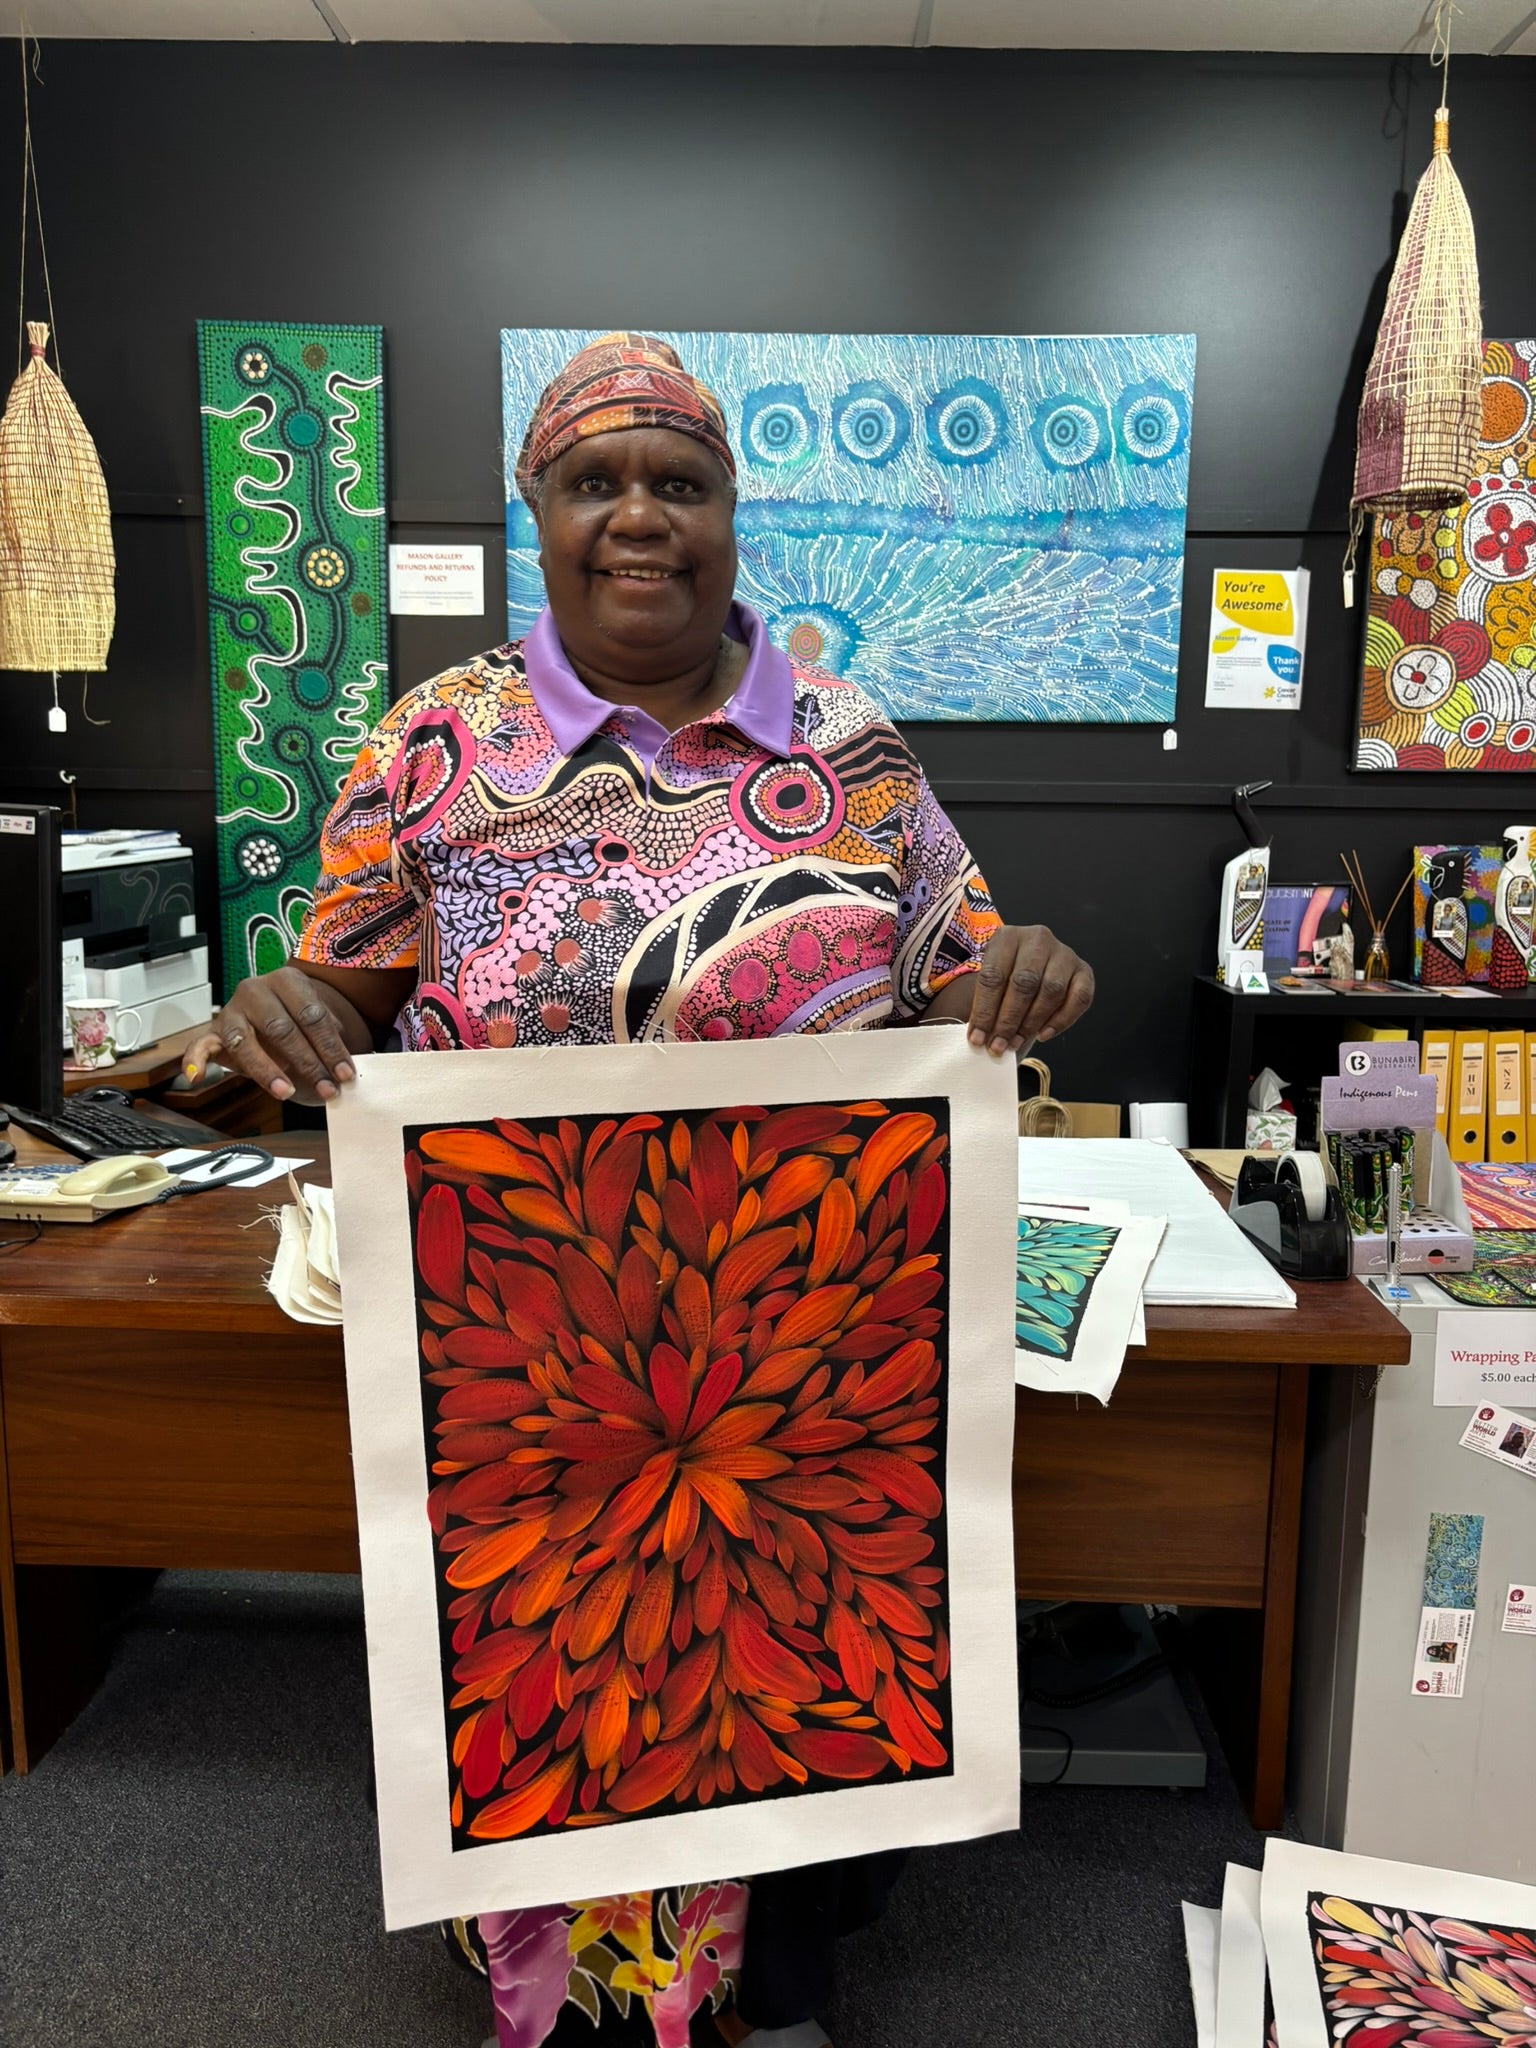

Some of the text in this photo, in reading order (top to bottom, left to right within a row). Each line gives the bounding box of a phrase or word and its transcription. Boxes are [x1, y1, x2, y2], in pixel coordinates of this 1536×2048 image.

[1221, 598, 1289, 611] Awesome!
[1273, 656, 1300, 665] Thank
[1372, 1056, 1416, 1064] BUNABIRI
[1340, 1085, 1418, 1102] Indigenous Pens
[1451, 1350, 1520, 1366] Wrapping
[1481, 1372, 1511, 1382] $5.00
[1473, 1424, 1496, 1436] WORLD
